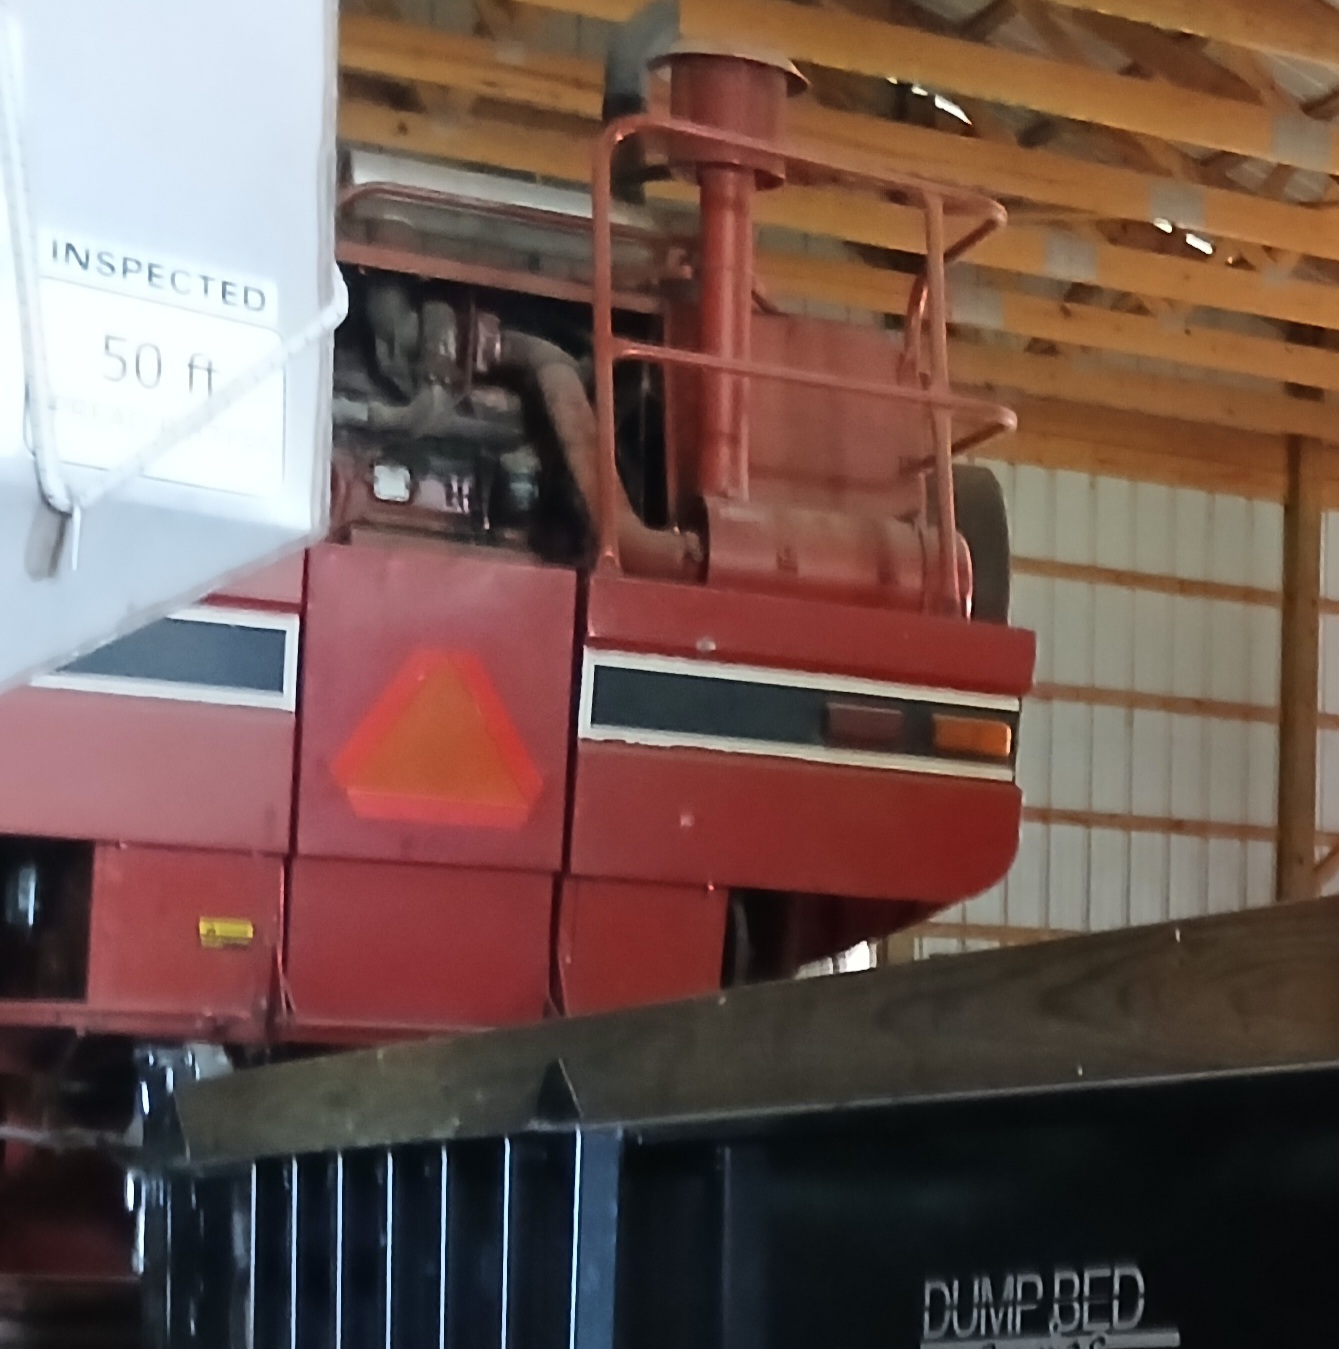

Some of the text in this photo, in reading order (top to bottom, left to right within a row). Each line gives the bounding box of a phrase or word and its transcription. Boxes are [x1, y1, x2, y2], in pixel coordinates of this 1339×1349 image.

[51, 239, 266, 312] INSPECTED
[103, 334, 217, 397] 50 ft
[923, 1266, 1146, 1340] DUMP BED
